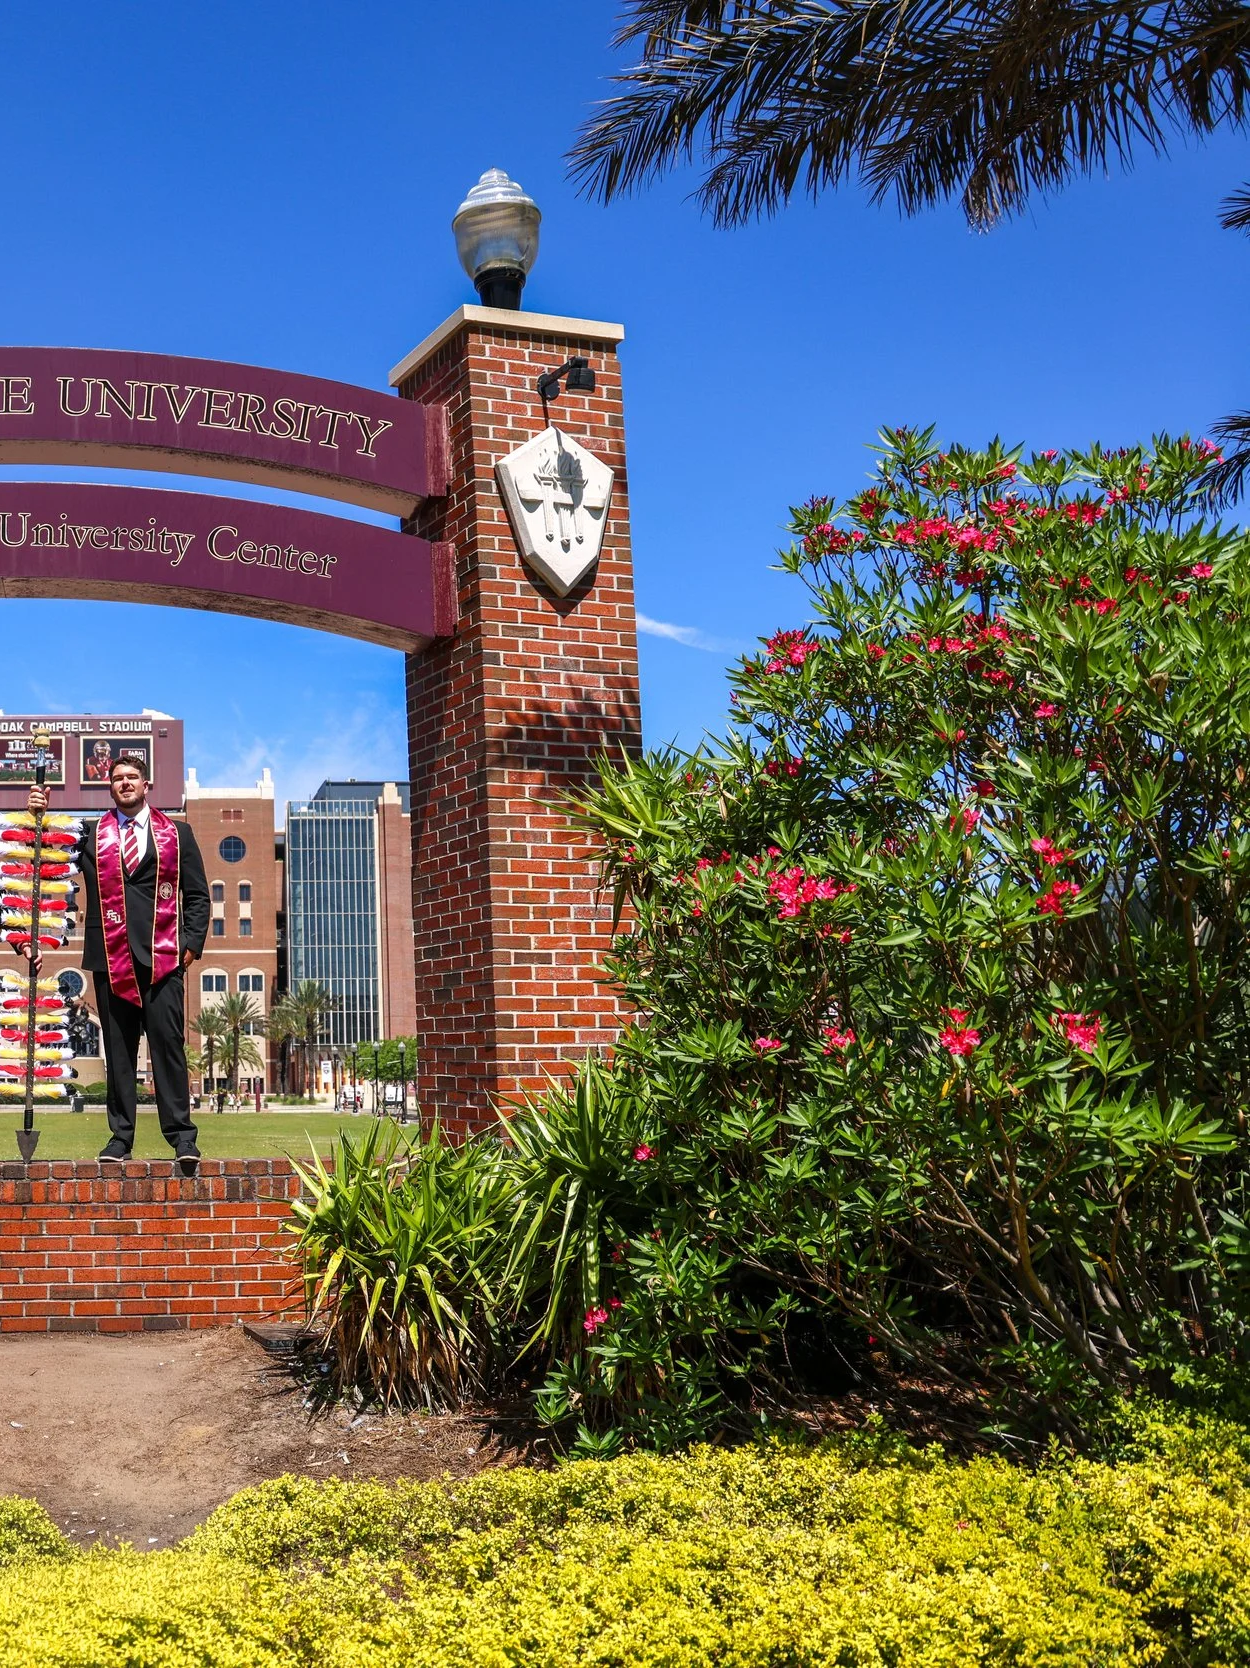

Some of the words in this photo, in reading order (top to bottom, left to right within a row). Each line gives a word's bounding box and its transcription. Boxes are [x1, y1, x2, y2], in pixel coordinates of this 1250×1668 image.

[56, 377, 393, 458] UNIVERSITY
[206, 525, 338, 579] Center
[30, 721, 93, 733] CAMPBELL
[99, 721, 152, 732] STADIUM
[106, 909, 122, 923] FSU
